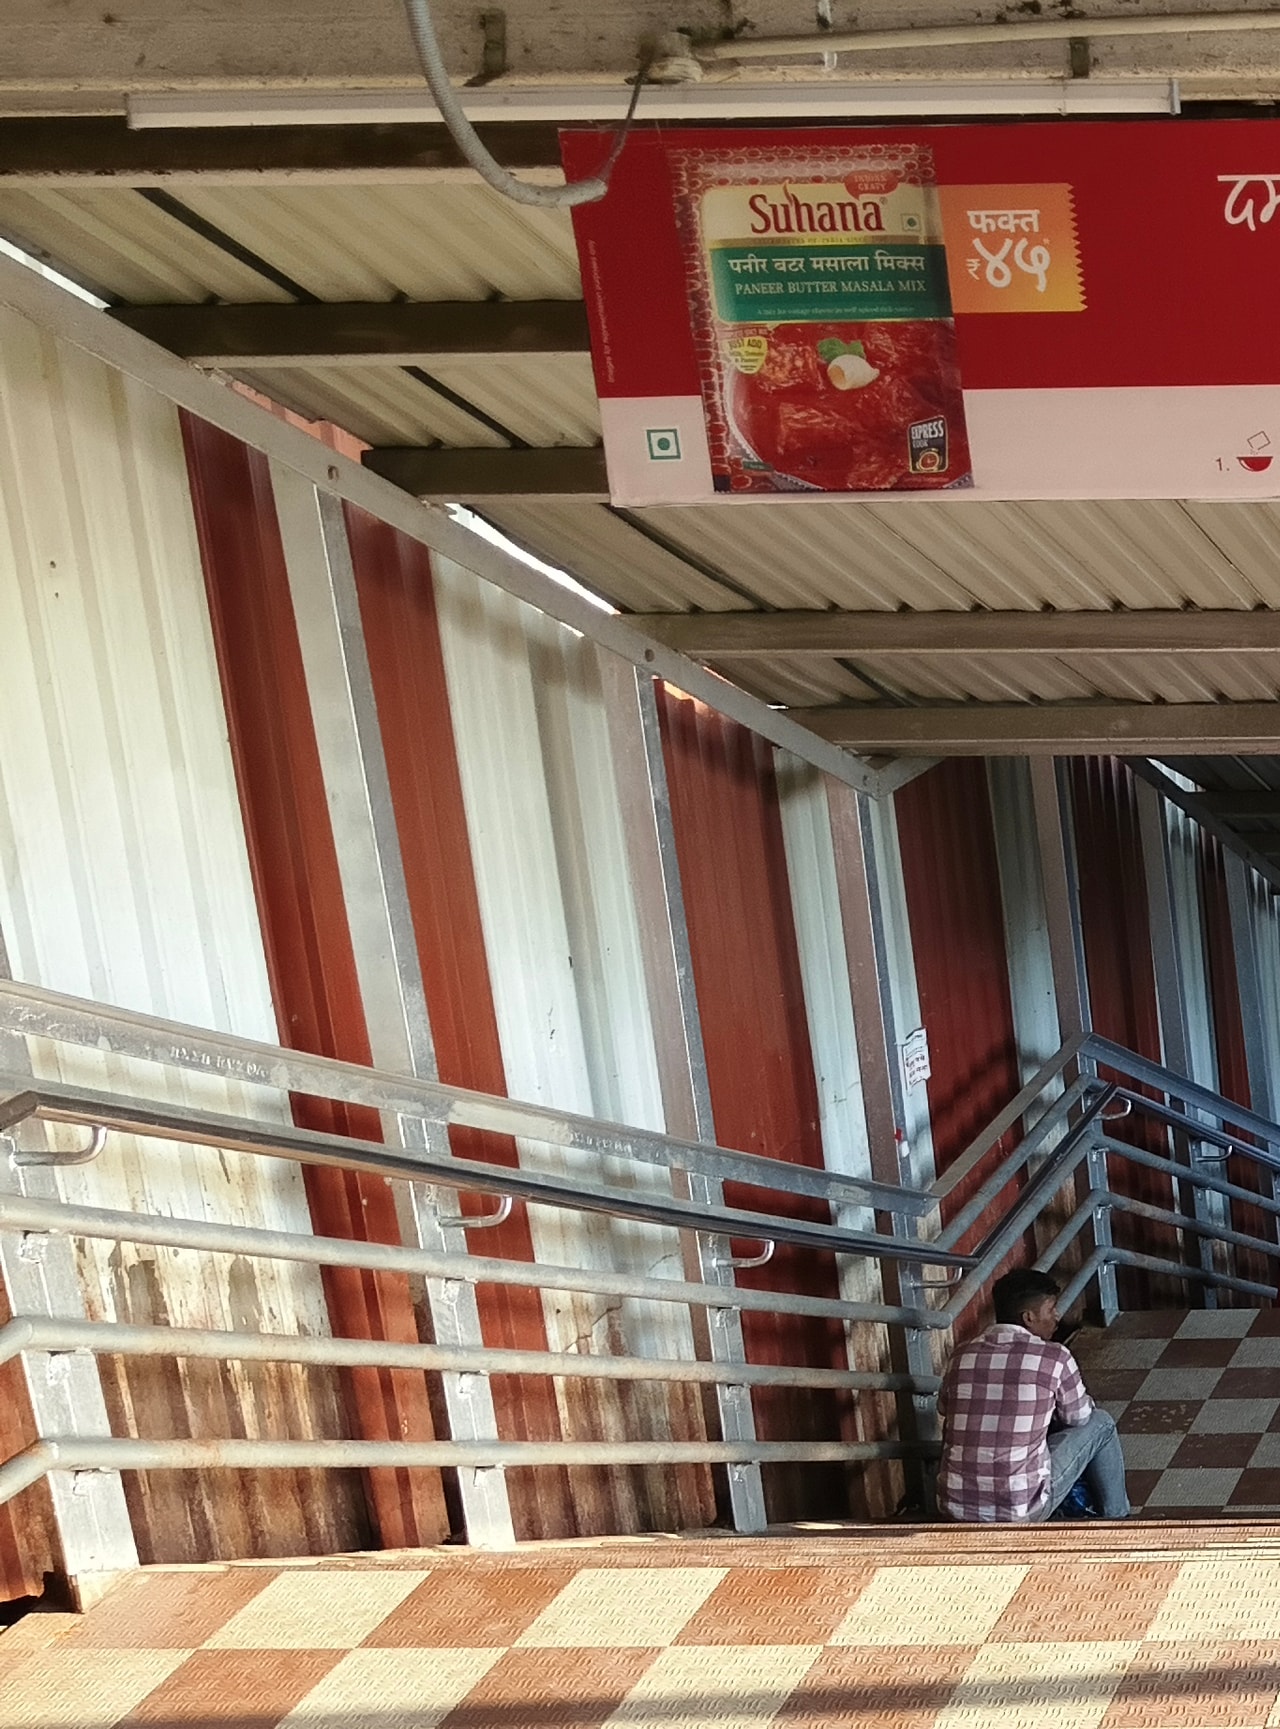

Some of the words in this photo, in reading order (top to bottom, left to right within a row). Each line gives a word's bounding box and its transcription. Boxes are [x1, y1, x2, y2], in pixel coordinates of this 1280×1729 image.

[749, 193, 885, 233] Suhana
[967, 209, 1040, 233] फक्त
[728, 253, 768, 274] पनीर
[772, 257, 805, 272] बटर
[809, 256, 870, 272] मसाला
[874, 250, 926, 271] मिक्स
[735, 281, 784, 295] PANEER
[787, 280, 837, 294] BUTTER
[841, 280, 895, 293] MASALA
[899, 280, 926, 292] MIX
[911, 420, 944, 440] EXPRESS
